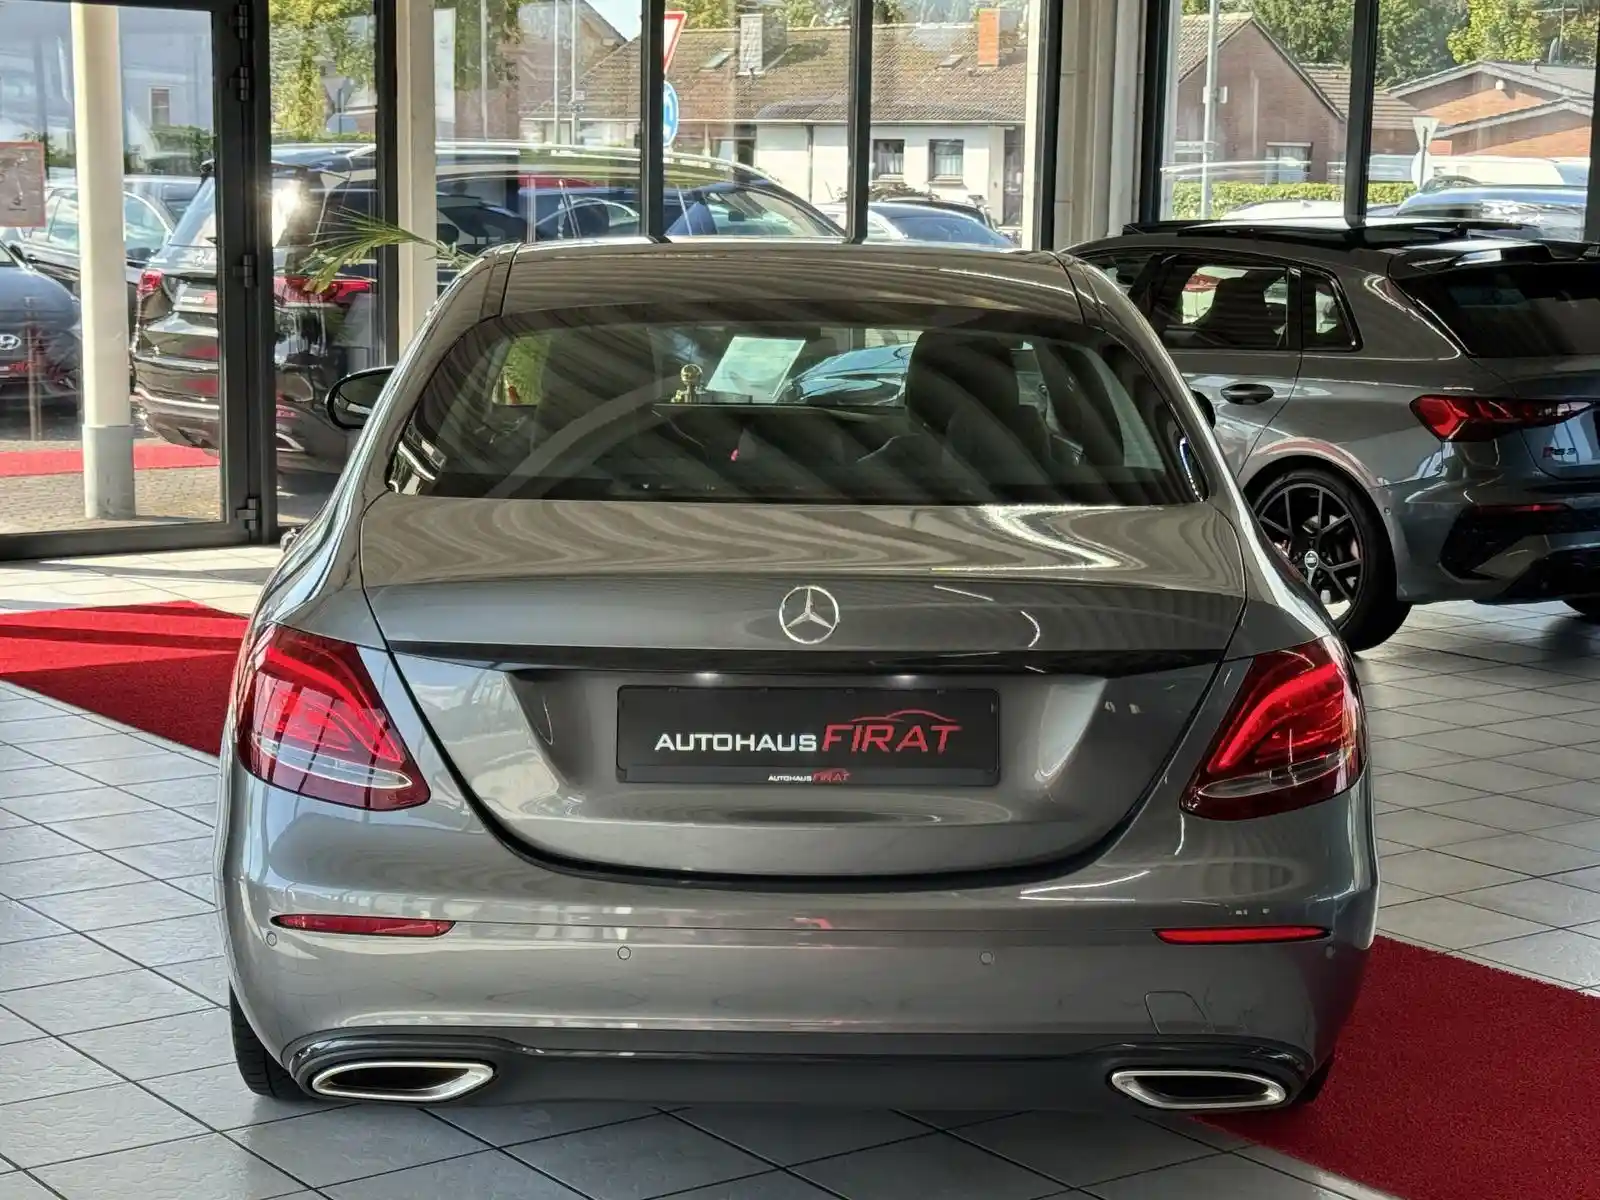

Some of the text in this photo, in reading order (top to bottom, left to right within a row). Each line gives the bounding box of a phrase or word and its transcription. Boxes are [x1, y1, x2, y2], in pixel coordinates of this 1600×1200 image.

[654, 724, 963, 754] AUTOHAUS FIRAT
[767, 771, 851, 782] AUTOHAUS FIRAT
